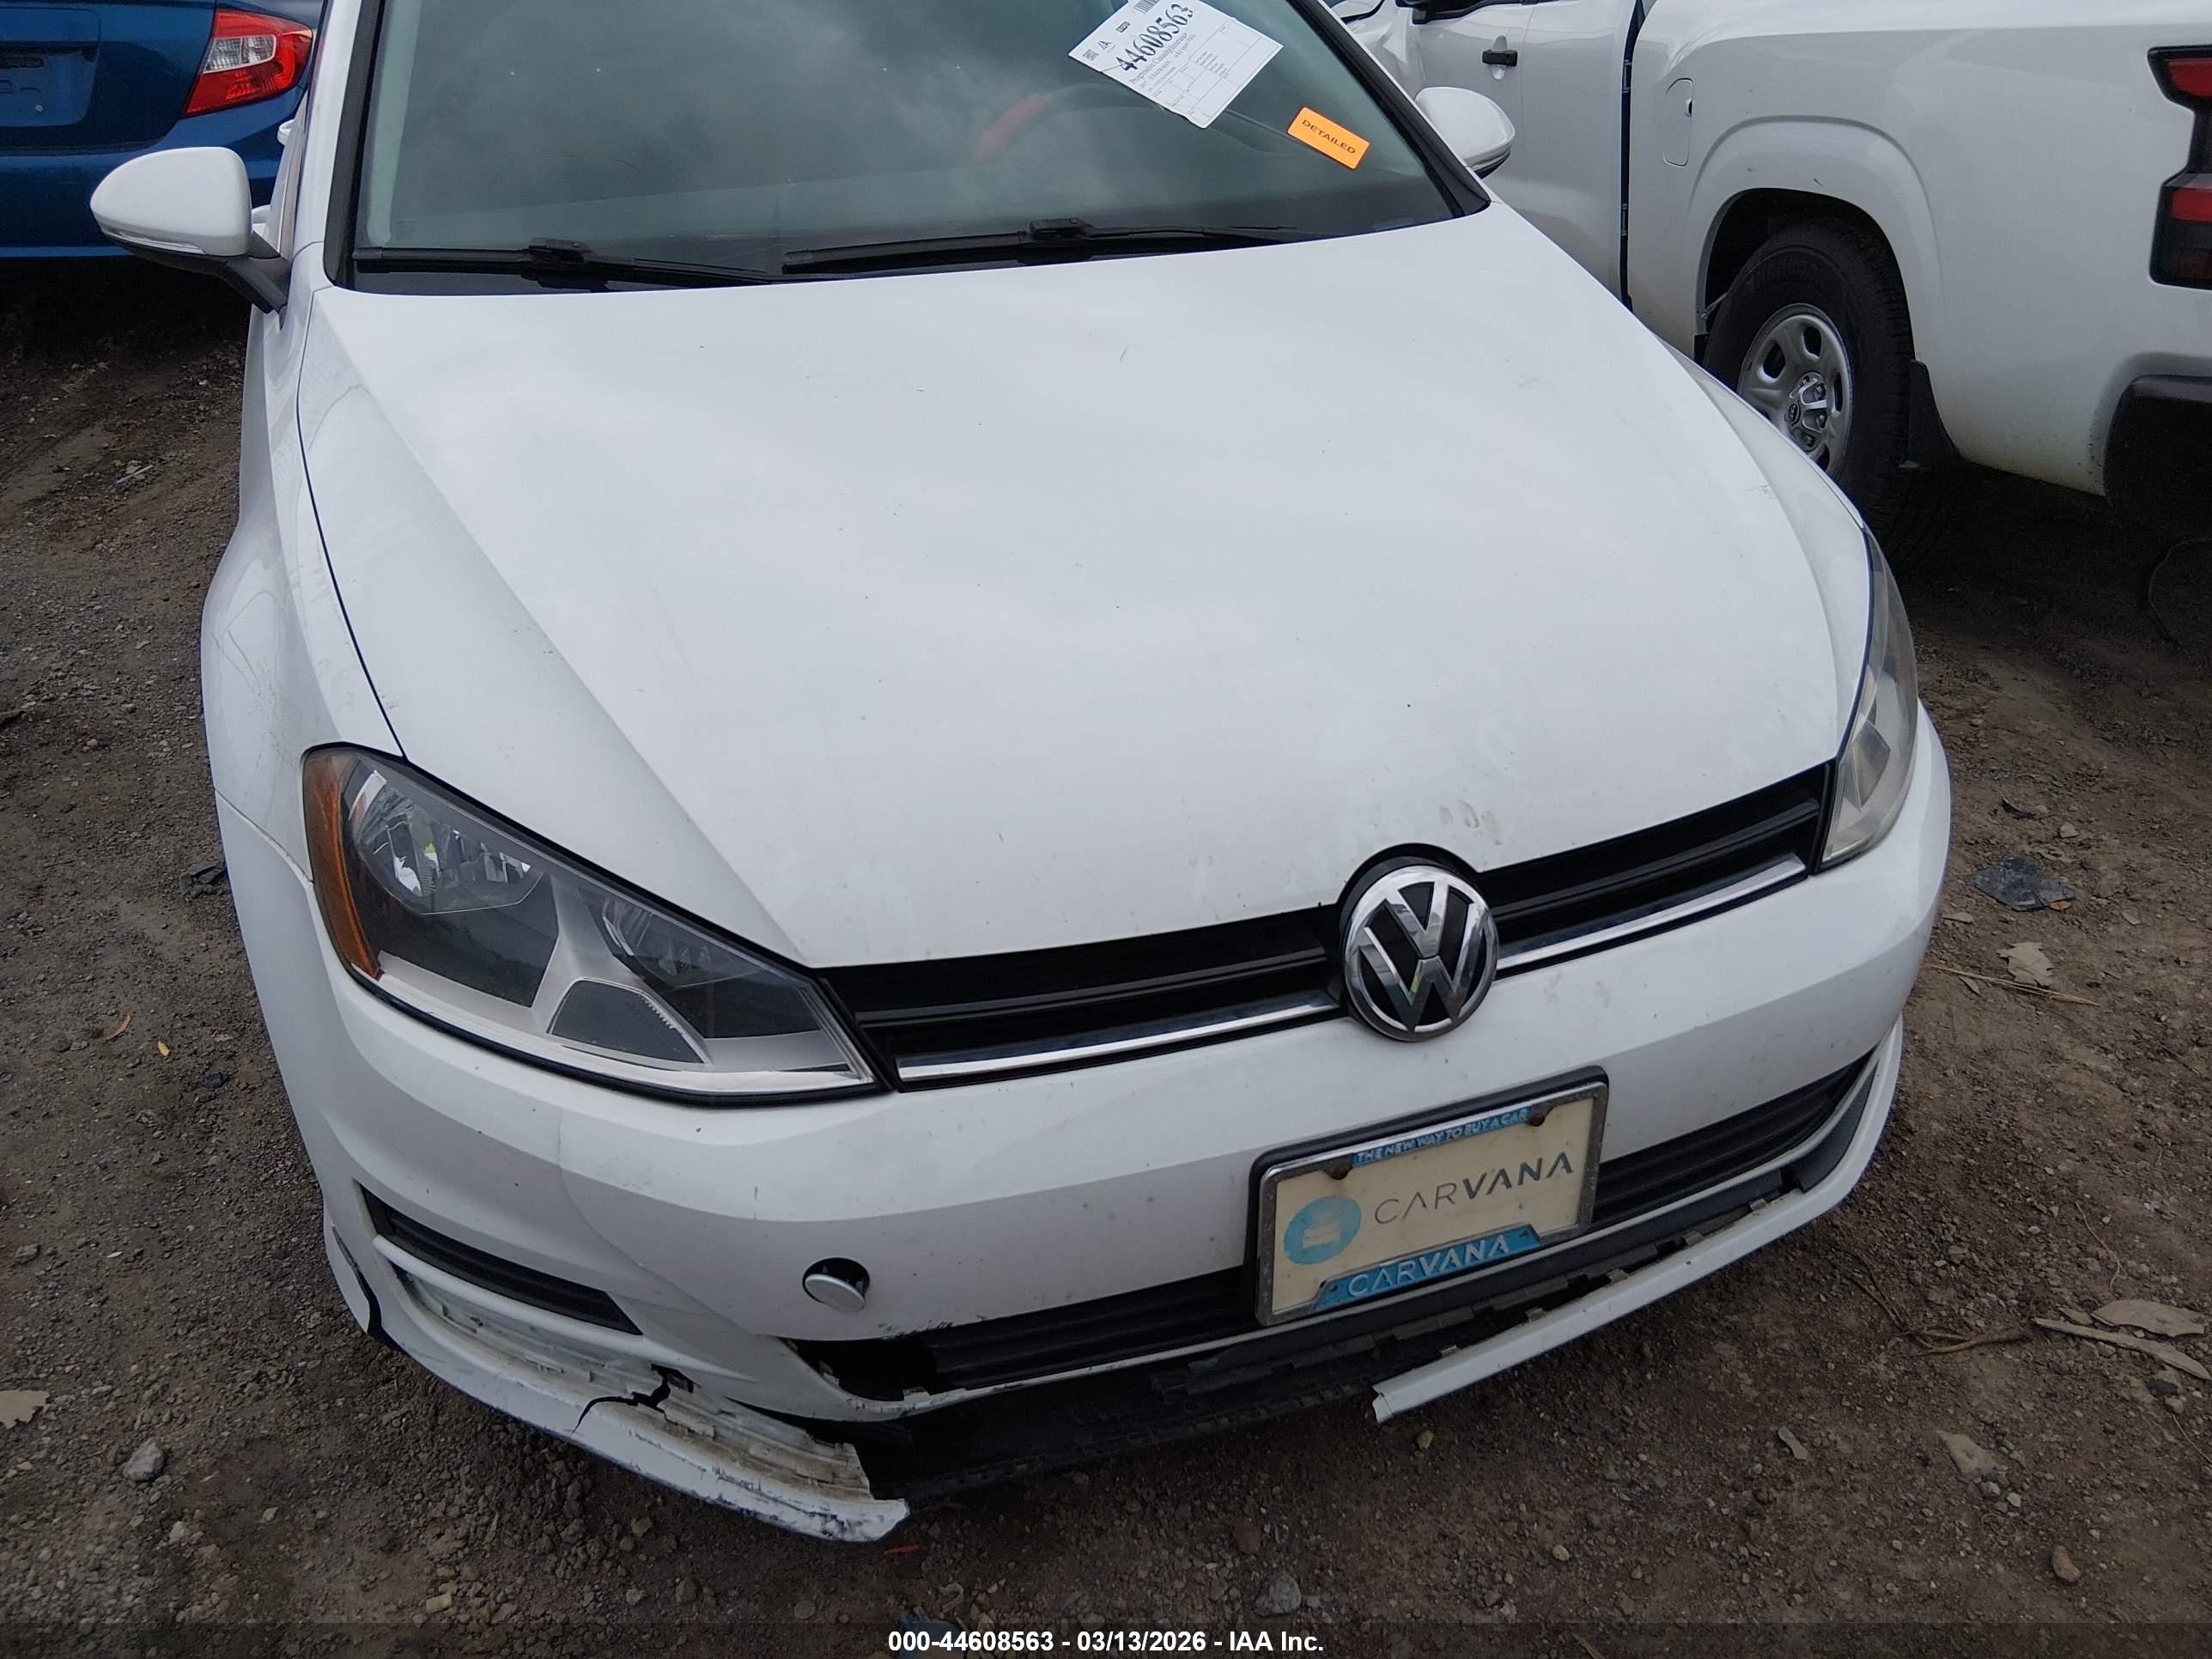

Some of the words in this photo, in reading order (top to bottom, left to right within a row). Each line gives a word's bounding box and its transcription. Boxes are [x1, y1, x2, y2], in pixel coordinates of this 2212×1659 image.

[1115, 3, 1194, 71] 44608563
[1302, 119, 1356, 154] DETAILED
[1357, 1149, 1382, 1163] THE
[1383, 1139, 1416, 1156] NEW
[1416, 1132, 1443, 1147] WAY
[1443, 1127, 1461, 1142] TO
[1464, 1119, 1488, 1136] BUY
[1489, 1116, 1501, 1129] A
[1501, 1108, 1528, 1126] CAR
[1374, 1152, 1573, 1224] CARVANA
[1348, 1234, 1510, 1297] CARVANA
